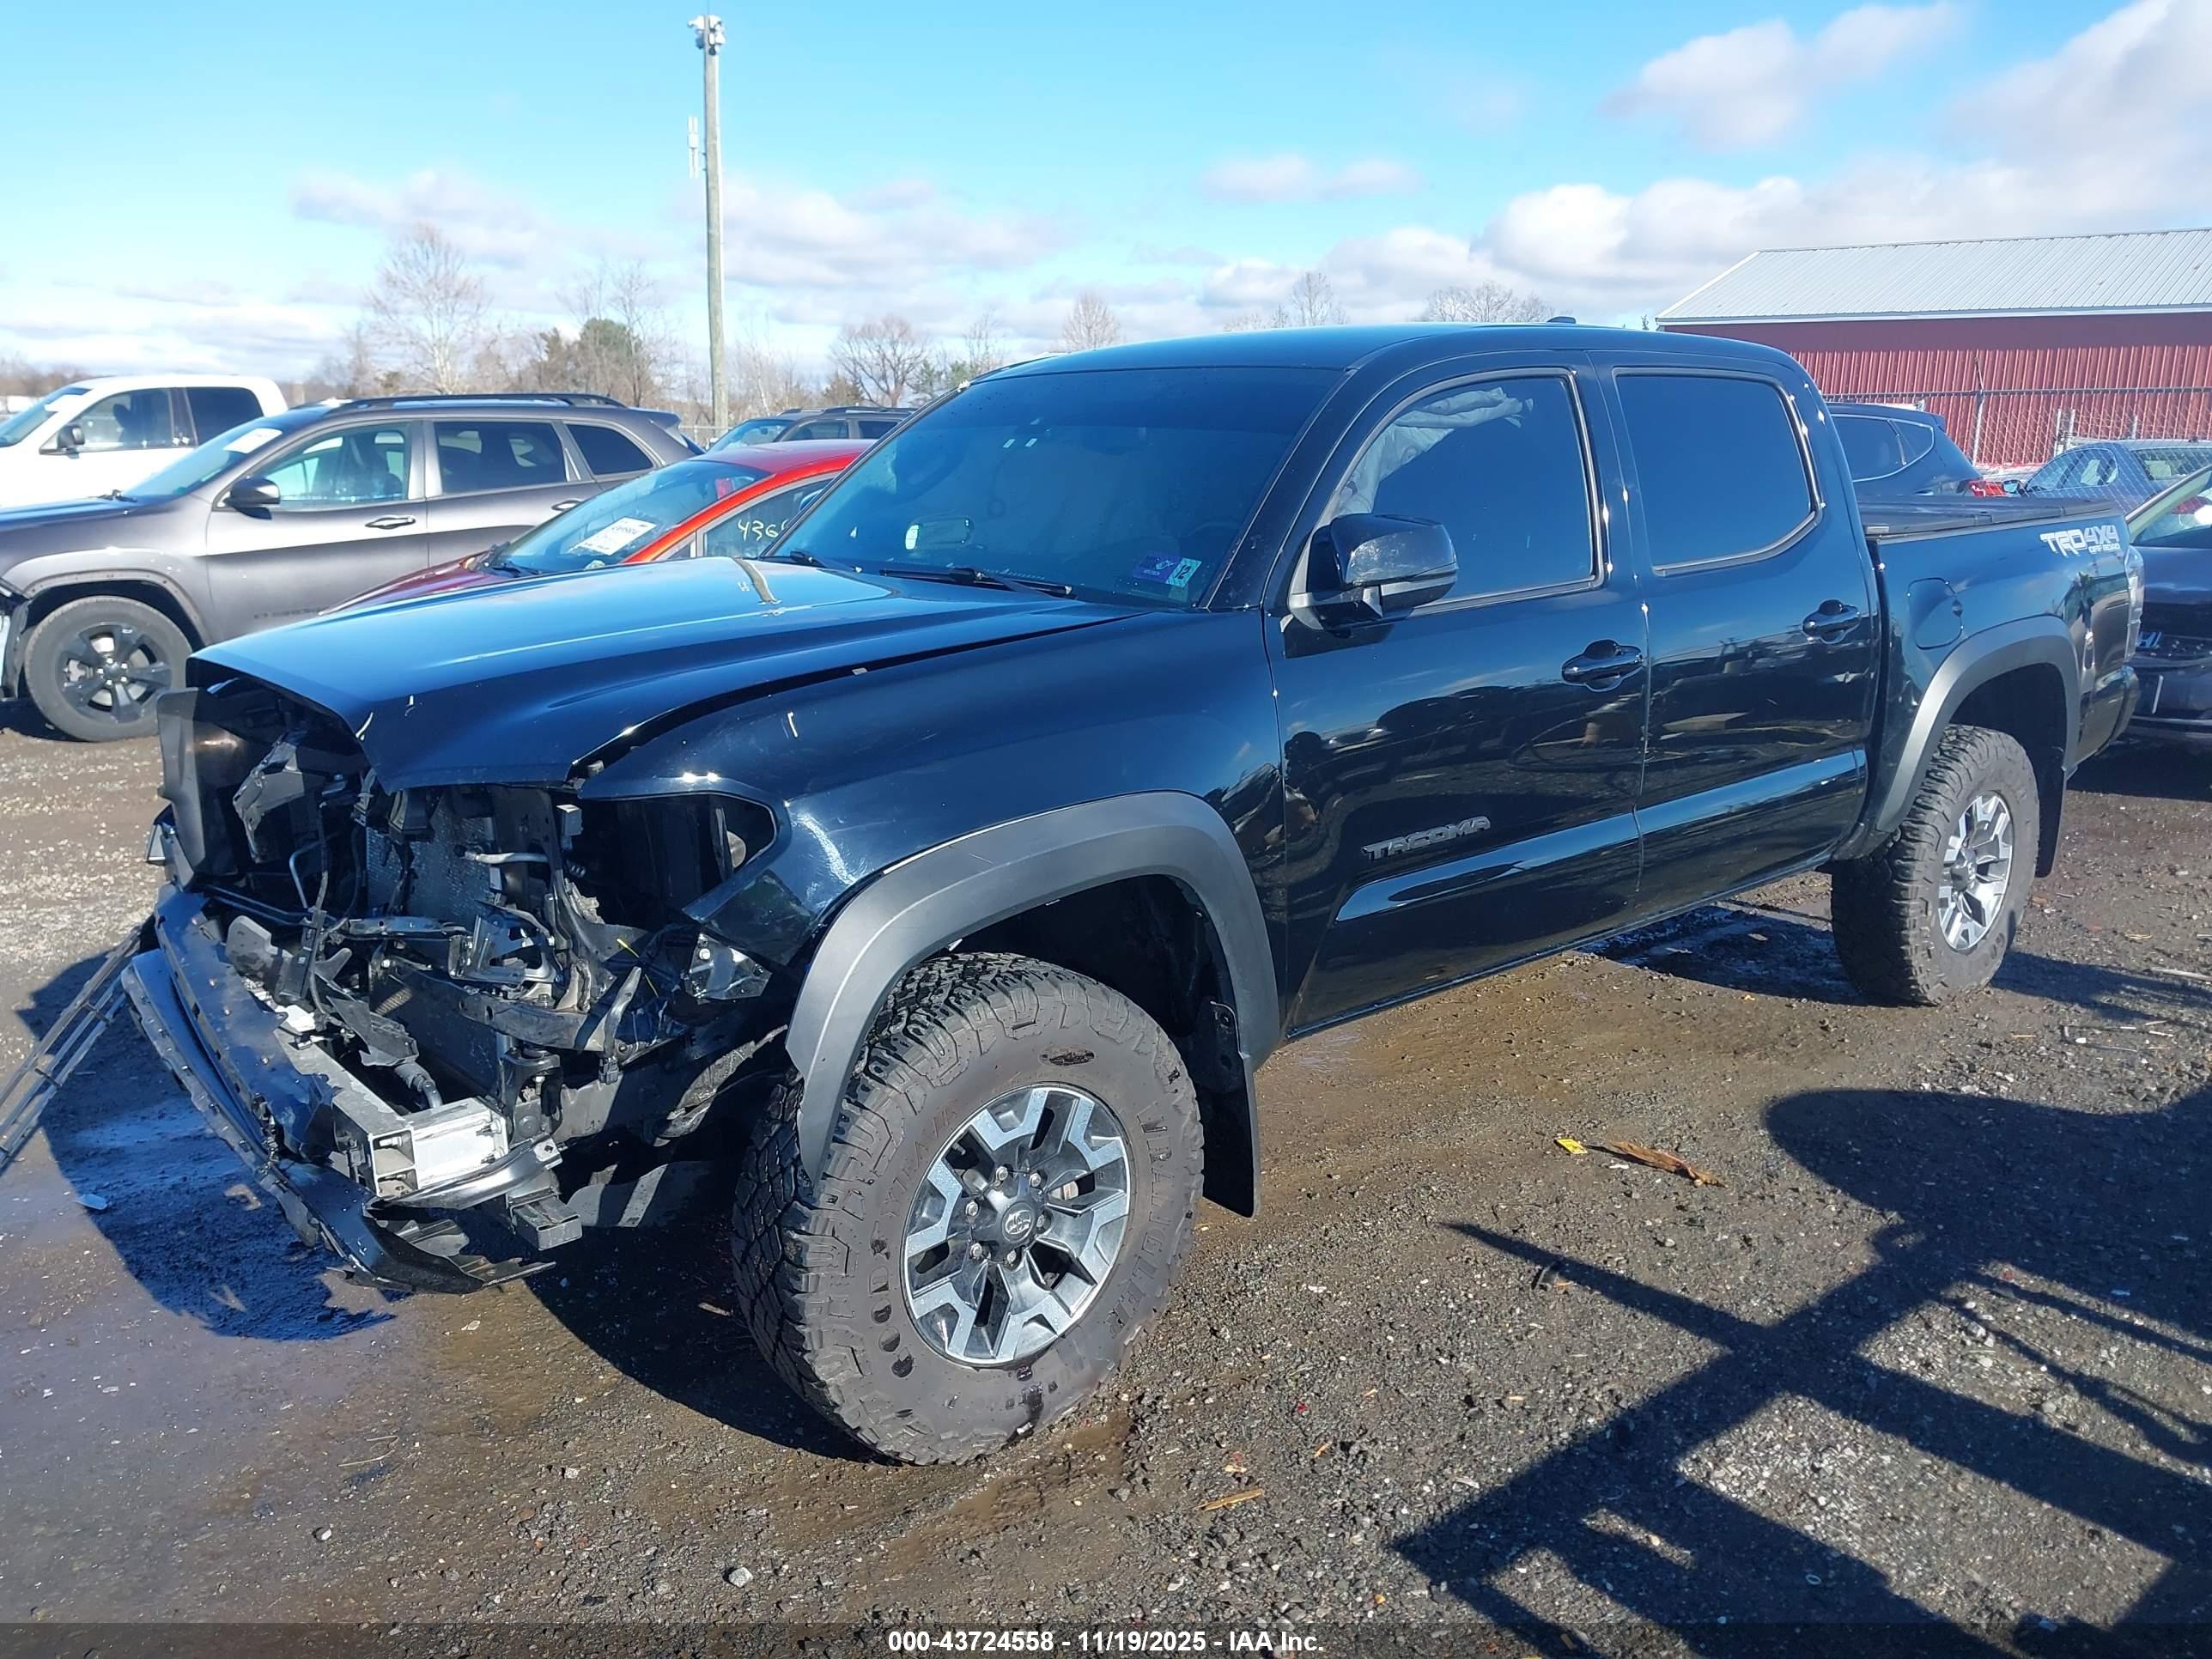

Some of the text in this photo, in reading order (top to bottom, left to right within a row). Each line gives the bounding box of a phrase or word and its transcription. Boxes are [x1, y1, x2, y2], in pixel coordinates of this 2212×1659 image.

[2040, 529, 2087, 557] TRD
[1174, 564, 1191, 580] 12
[1361, 816, 1491, 860] TACOMA
